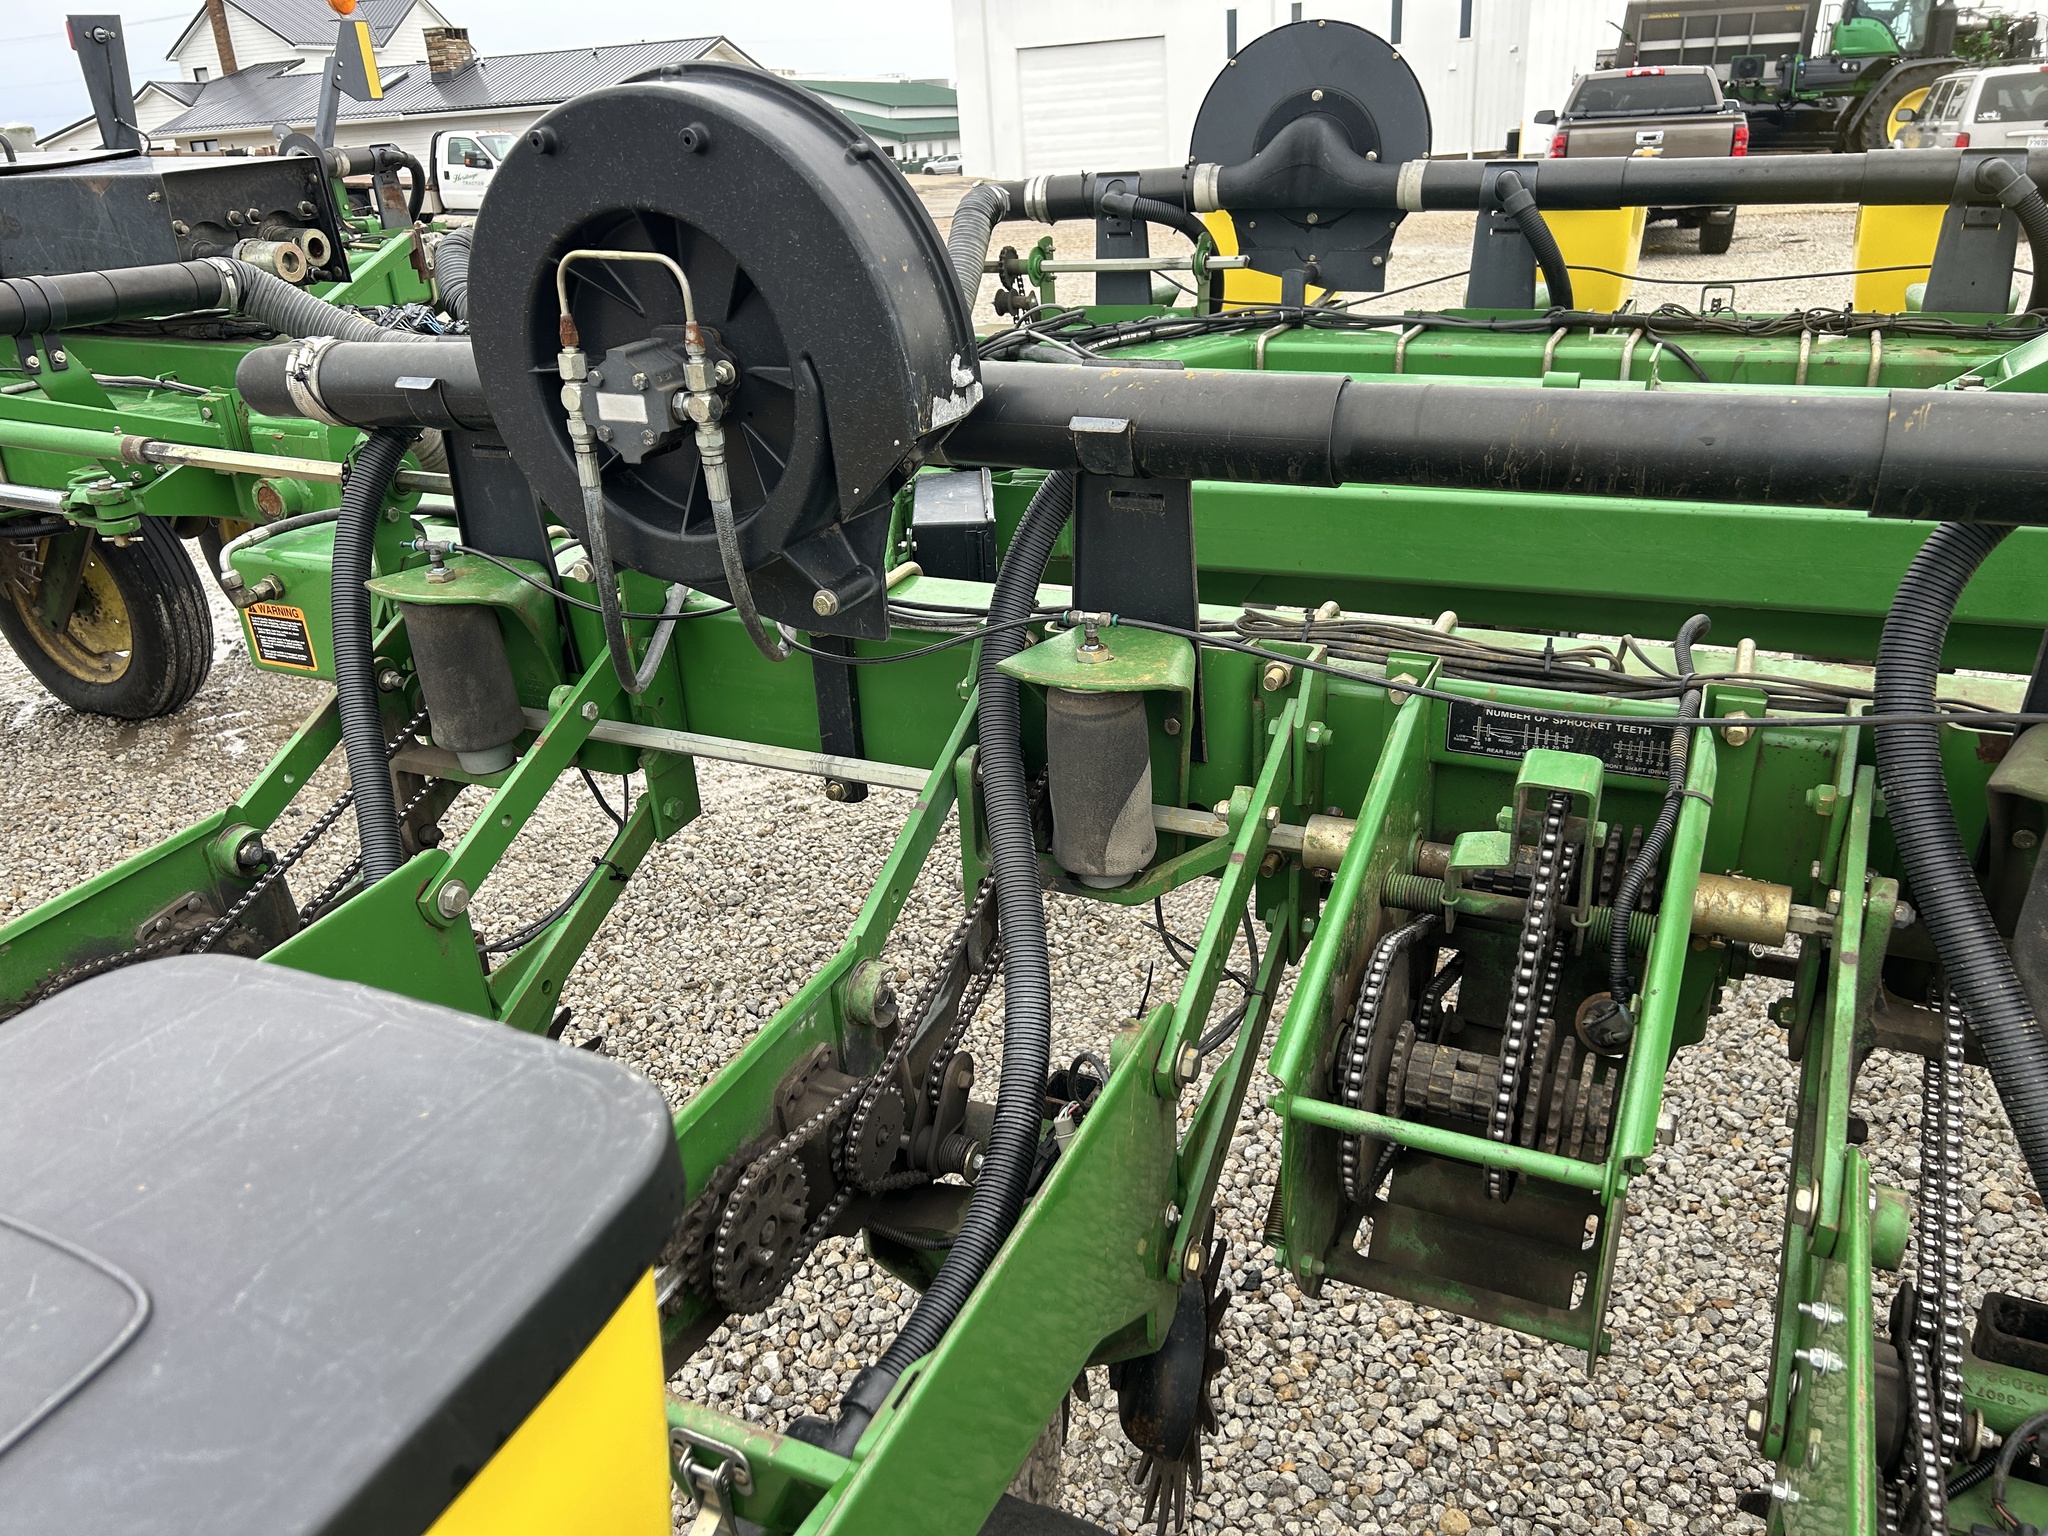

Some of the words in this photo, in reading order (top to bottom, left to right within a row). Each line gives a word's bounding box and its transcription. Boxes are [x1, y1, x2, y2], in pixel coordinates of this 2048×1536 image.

[257, 604, 299, 618] WARNING
[1486, 709, 1531, 720] NUMBER
[1552, 718, 1612, 730] SPROCKET
[1616, 724, 1652, 736] TEETH
[1604, 762, 1623, 770] RONT
[1624, 765, 1646, 773] SHAFT
[1647, 768, 1669, 776] (DRIVE
